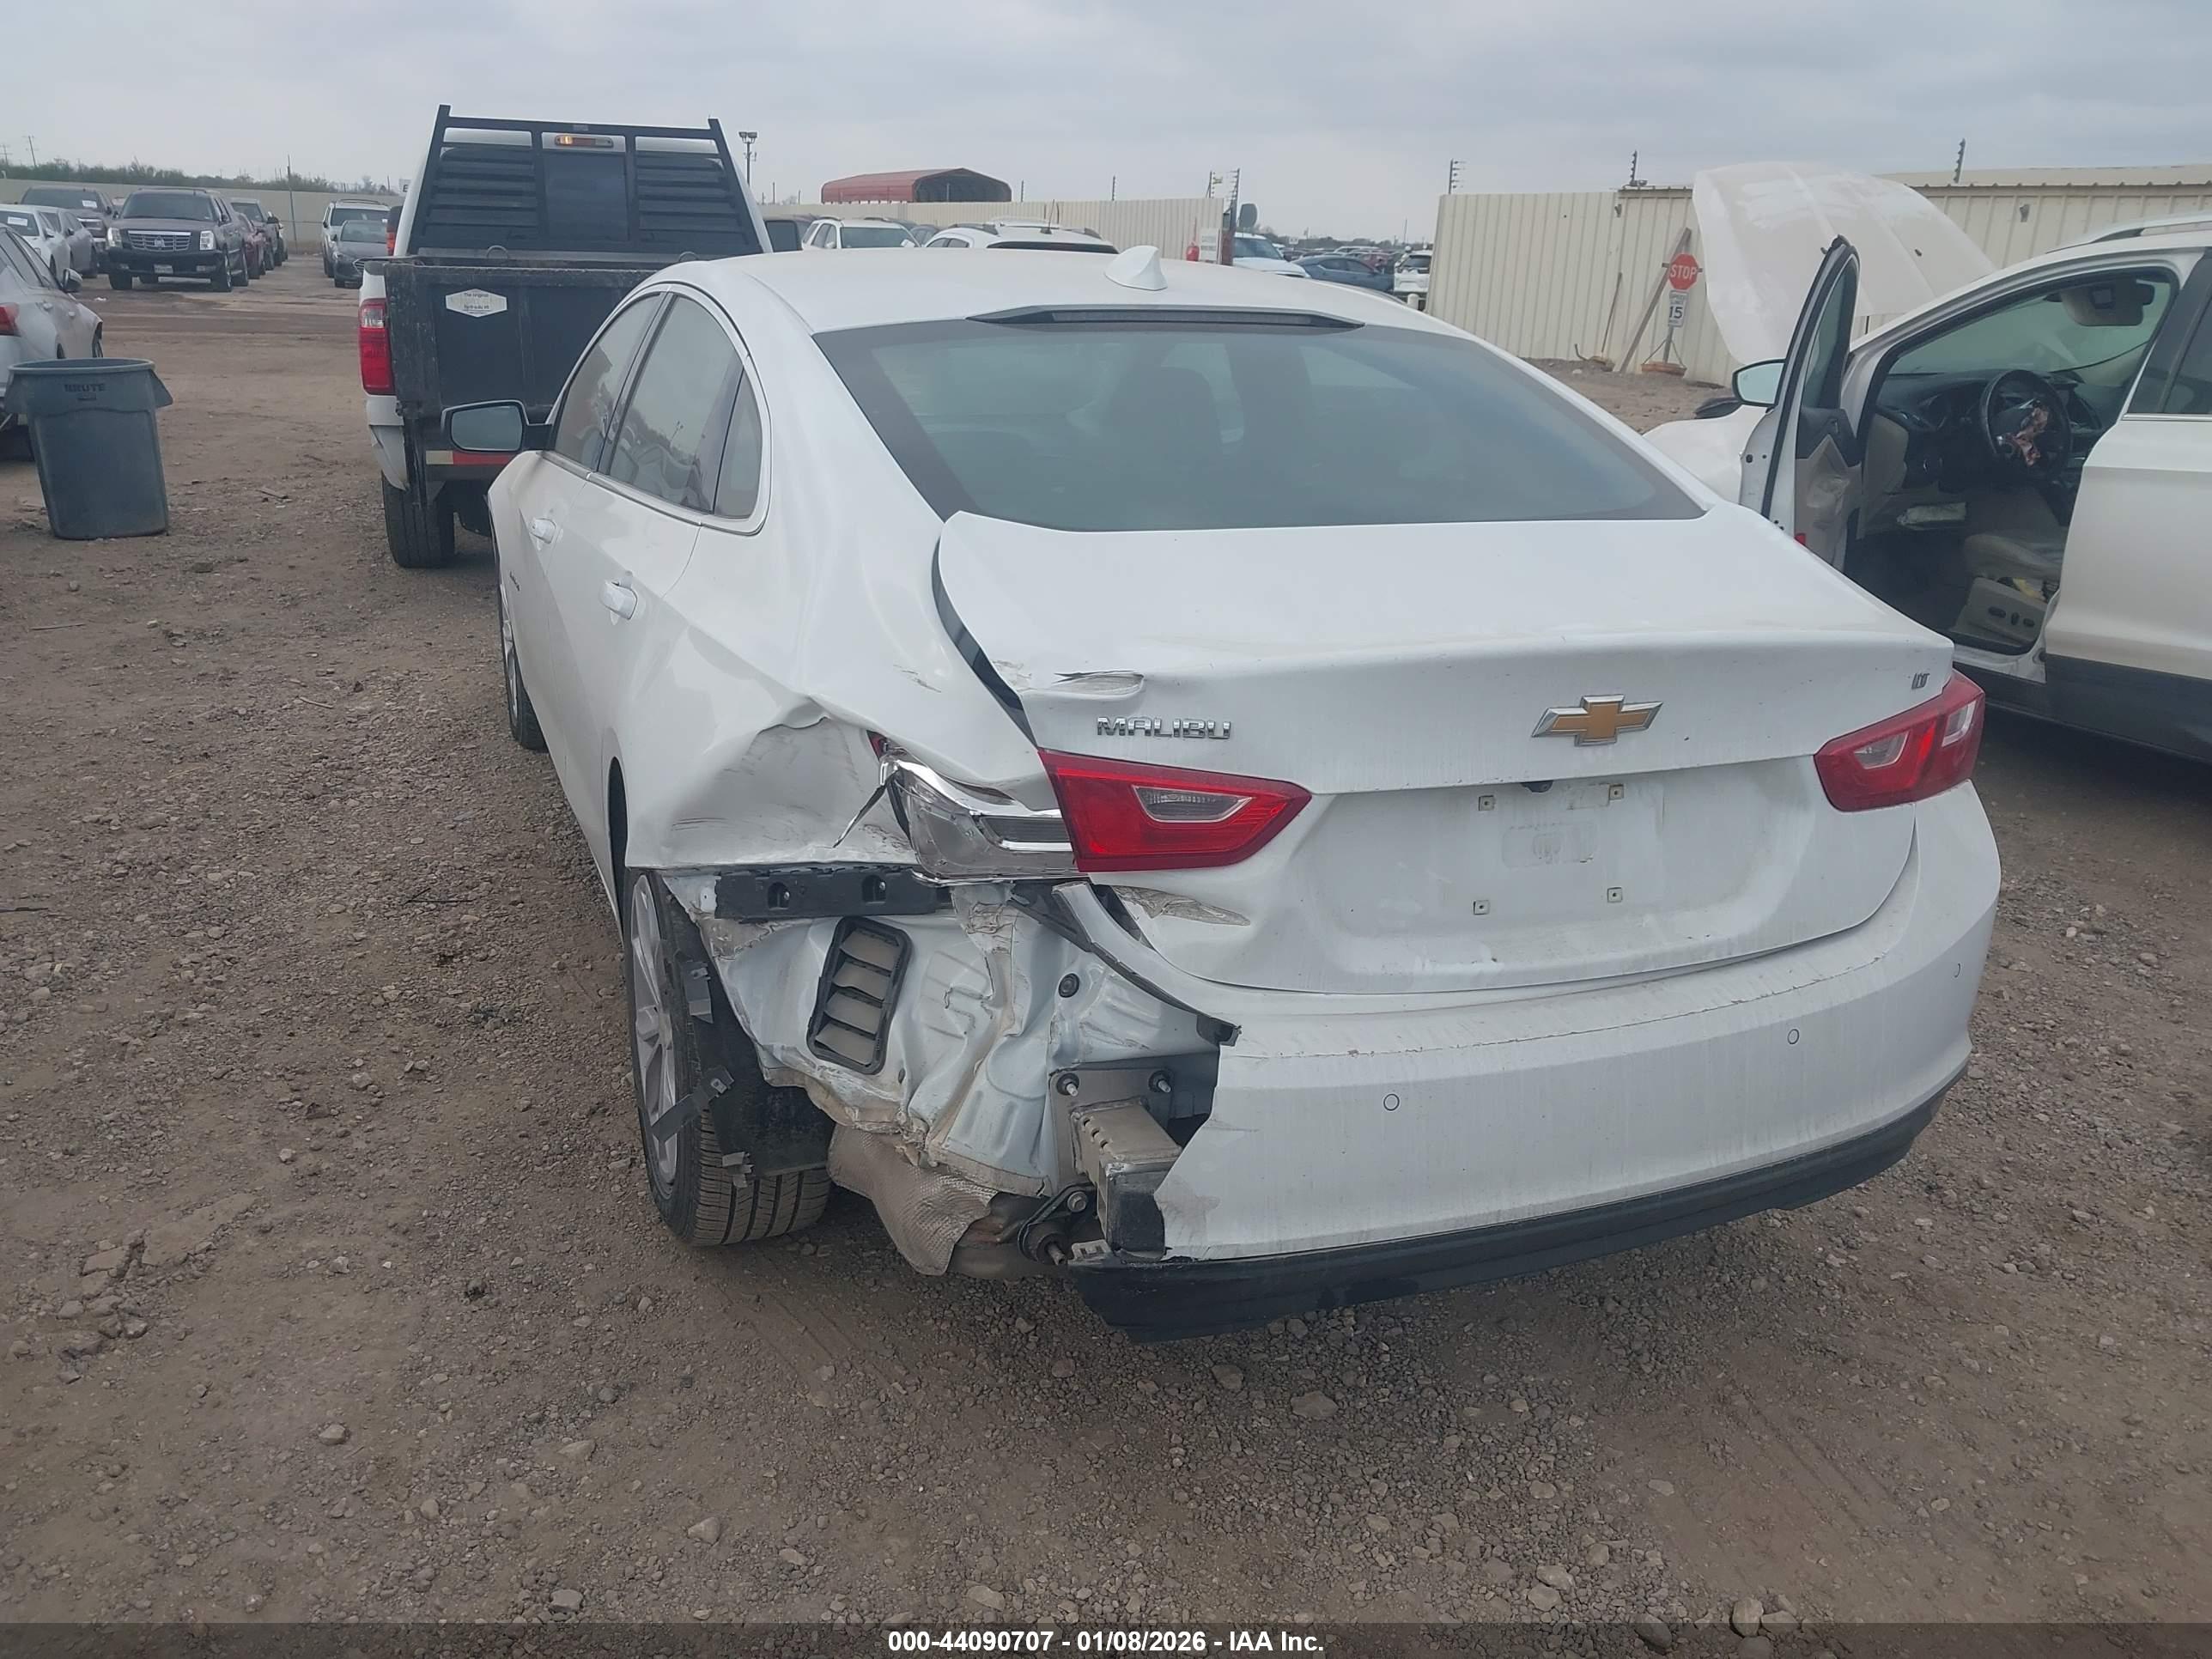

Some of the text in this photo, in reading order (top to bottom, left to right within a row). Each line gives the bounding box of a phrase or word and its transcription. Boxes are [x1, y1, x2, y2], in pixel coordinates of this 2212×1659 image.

[1670, 264, 1698, 280] STOP
[1669, 306, 1683, 319] 15
[1097, 716, 1231, 739] MALIBU
